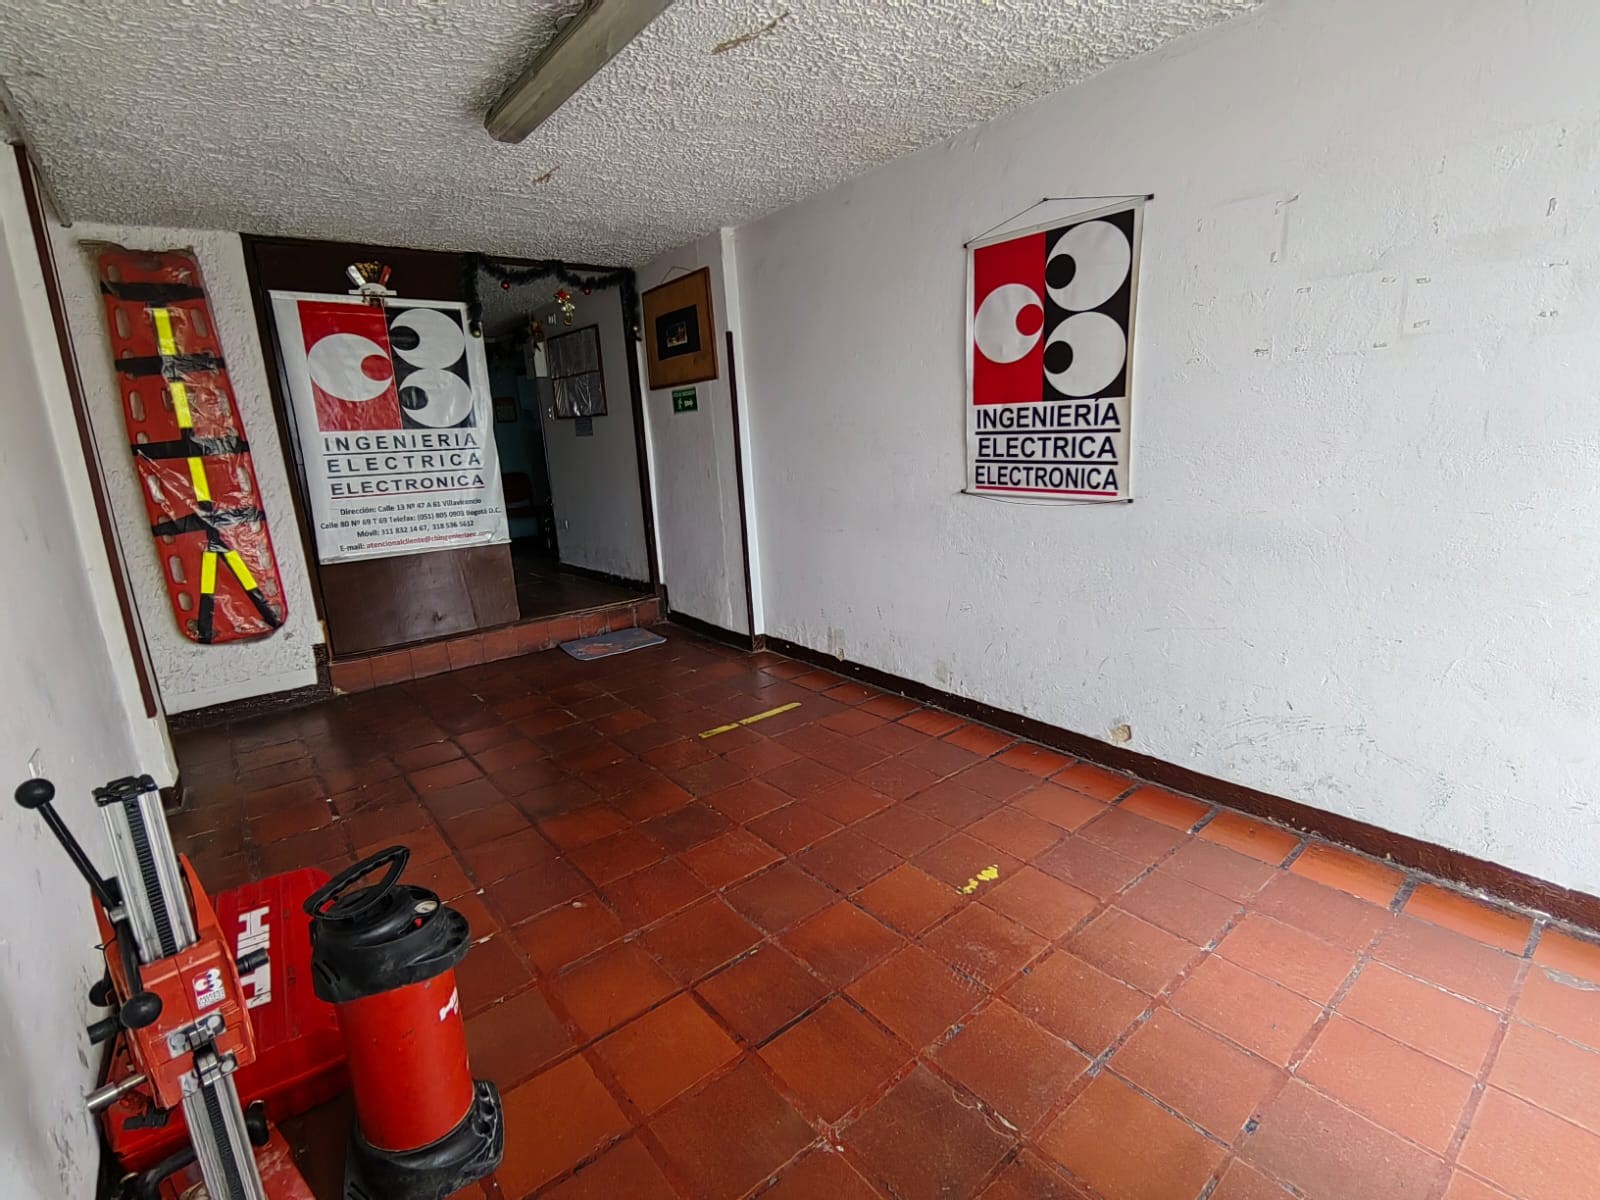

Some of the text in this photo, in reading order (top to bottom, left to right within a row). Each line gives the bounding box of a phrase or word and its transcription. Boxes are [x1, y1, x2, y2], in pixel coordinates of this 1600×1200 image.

[977, 398, 1120, 429] INGENIERÍA
[324, 433, 478, 452] INGENIERIA
[978, 436, 1117, 459] ELECTRICA
[327, 453, 481, 473] ELECTRICA
[331, 475, 484, 496] ELECTRONICA
[975, 465, 1119, 490] ELECTRONICA
